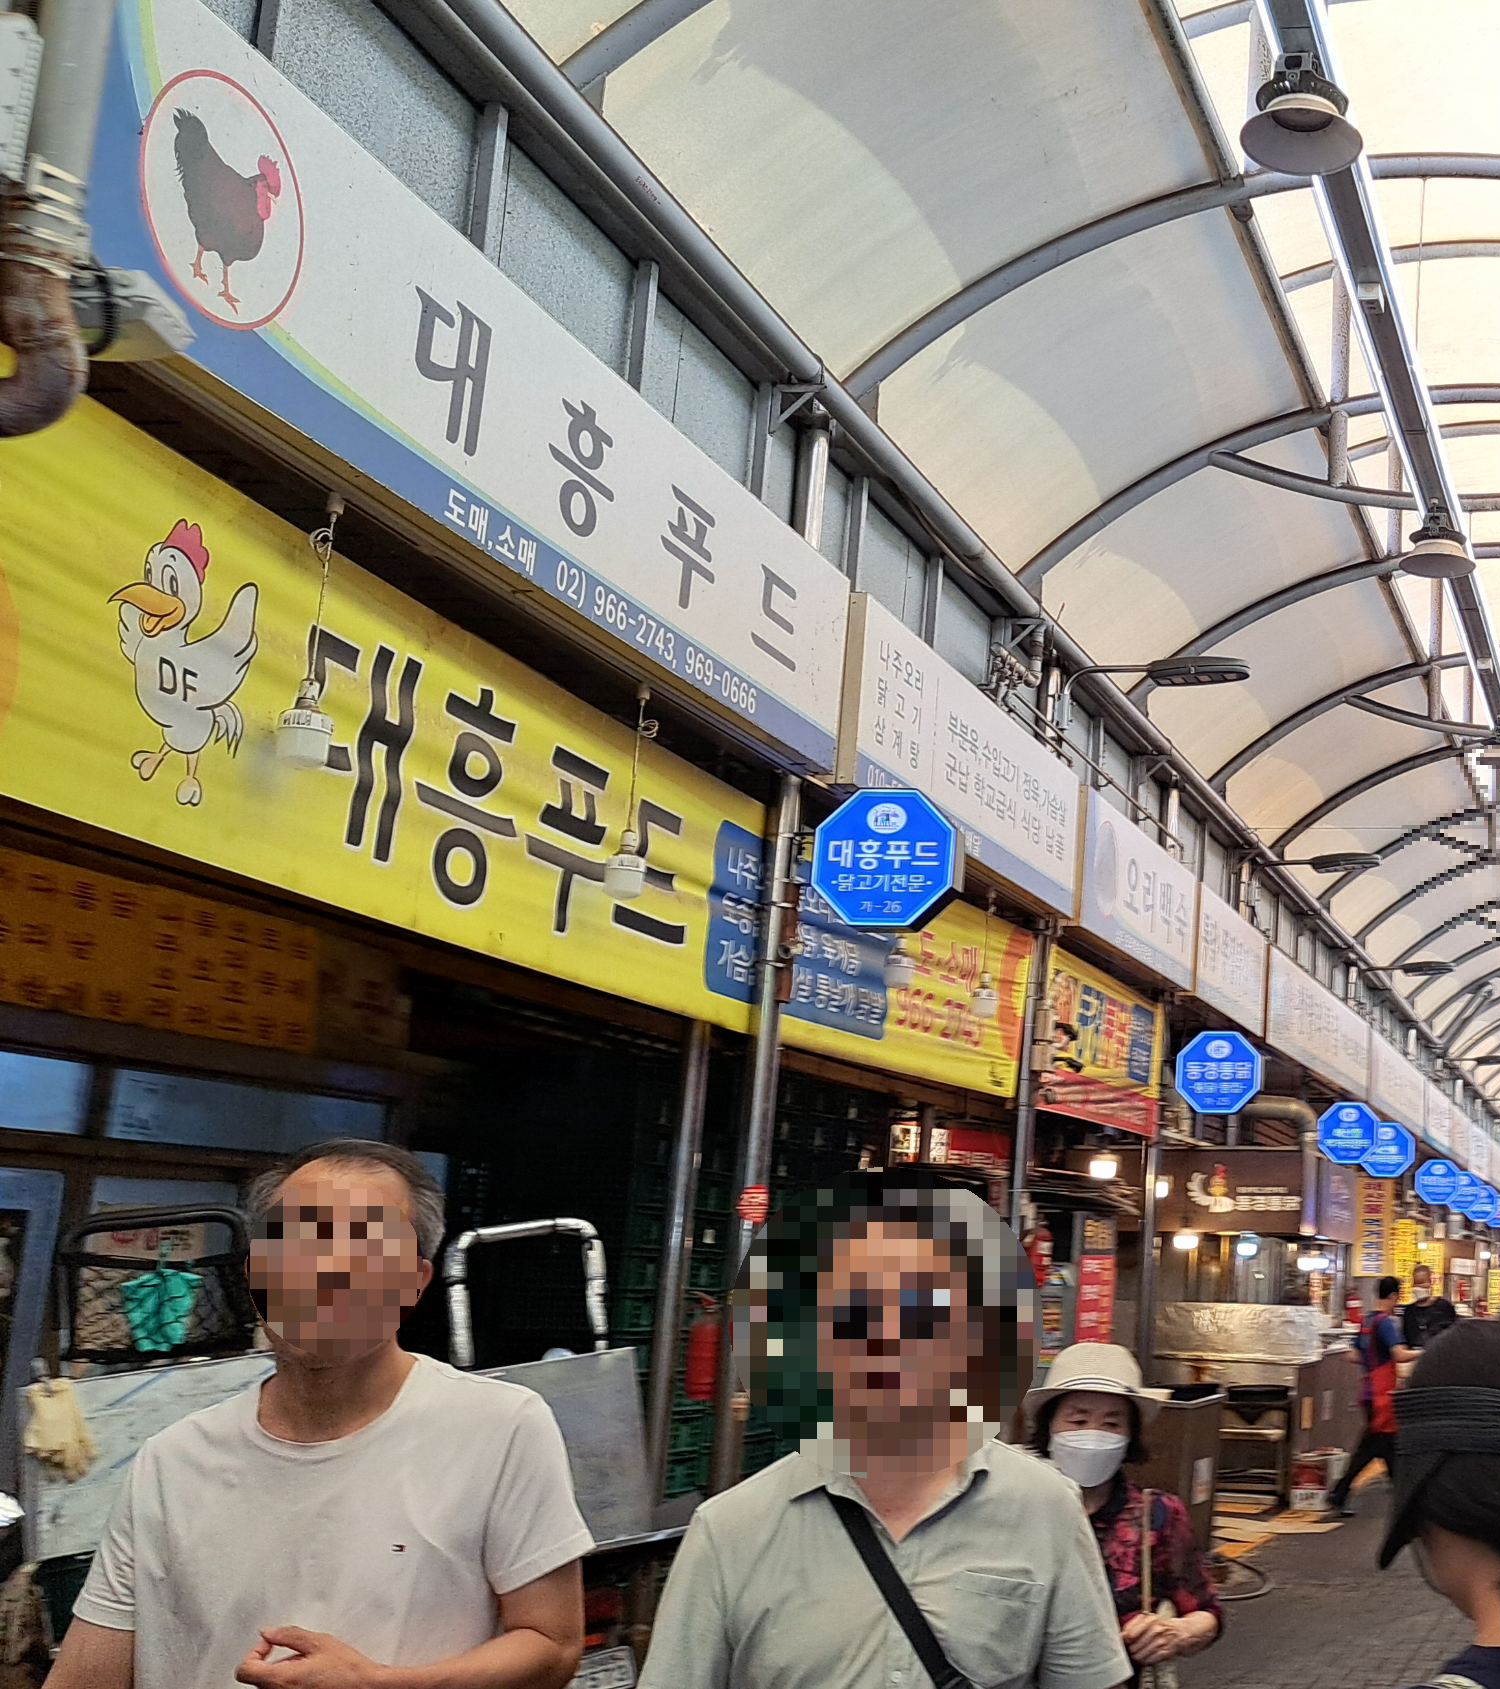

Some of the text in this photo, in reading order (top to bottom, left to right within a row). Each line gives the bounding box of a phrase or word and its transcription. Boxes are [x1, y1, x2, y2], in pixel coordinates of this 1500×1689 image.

[415, 285, 797, 673] 대흥푸드
[443, 487, 758, 715] 도매,소매 02) 966-2743, 969-0666
[879, 640, 924, 698] 나주오리
[156, 655, 200, 702] DF
[293, 622, 689, 947] 대흥푸드
[827, 839, 941, 870] 대흥푸드
